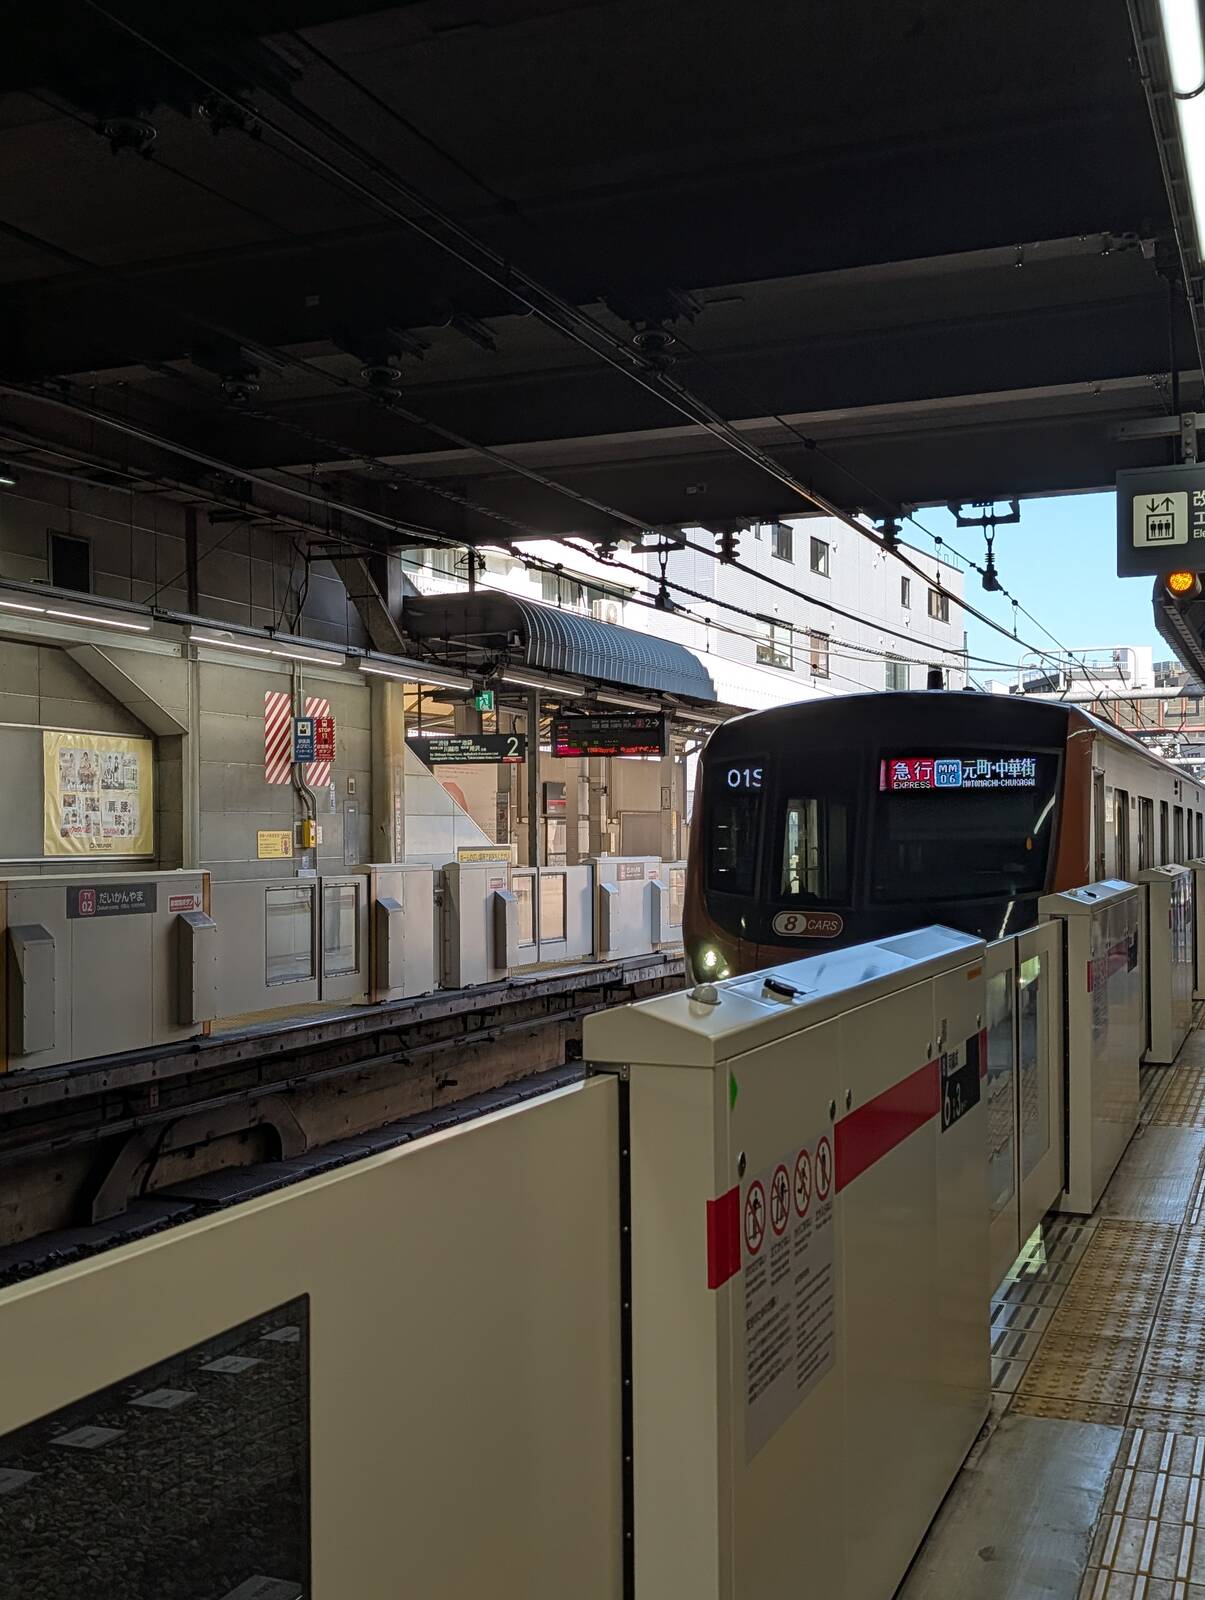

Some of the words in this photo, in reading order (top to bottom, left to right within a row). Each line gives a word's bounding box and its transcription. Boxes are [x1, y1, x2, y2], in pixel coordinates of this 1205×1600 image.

[507, 736, 519, 757] 2
[892, 761, 933, 781] 急行
[938, 764, 958, 773] MM
[962, 758, 1037, 779] 元町・中華街
[940, 774, 956, 784] 06
[962, 778, 1036, 788] MOTOMACHI-CHUKAGAI
[893, 781, 932, 790] EXPRESS
[83, 892, 91, 900] TY
[99, 891, 144, 904] だいかんやま
[81, 902, 93, 912] 02
[784, 915, 798, 931] 8
[807, 919, 838, 931] CARS
